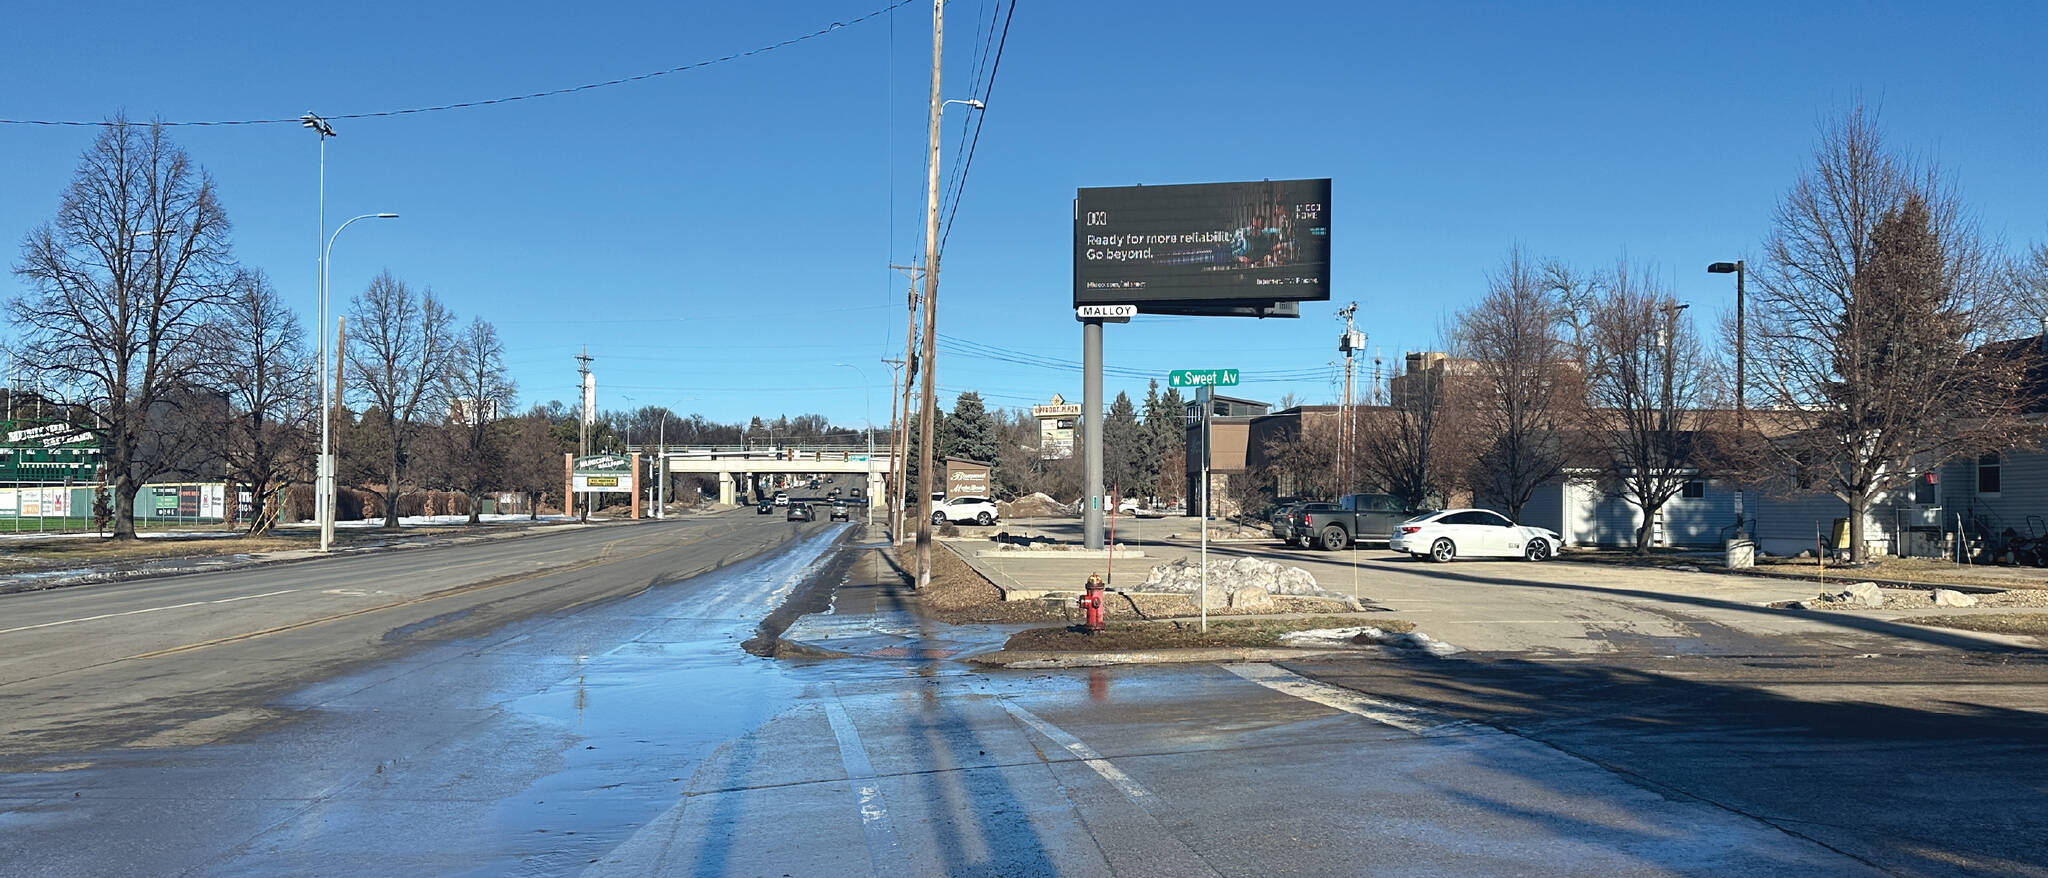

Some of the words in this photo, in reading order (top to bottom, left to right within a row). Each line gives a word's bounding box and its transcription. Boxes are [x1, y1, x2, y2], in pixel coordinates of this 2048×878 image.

[1087, 234, 1124, 247] Ready
[1127, 233, 1144, 244] for
[1147, 234, 1177, 245] more
[1086, 248, 1104, 260] Go
[1106, 246, 1154, 262] beyond.
[1083, 306, 1131, 316] MALLOY
[1184, 370, 1217, 385] Sweet
[1222, 369, 1237, 384] Av
